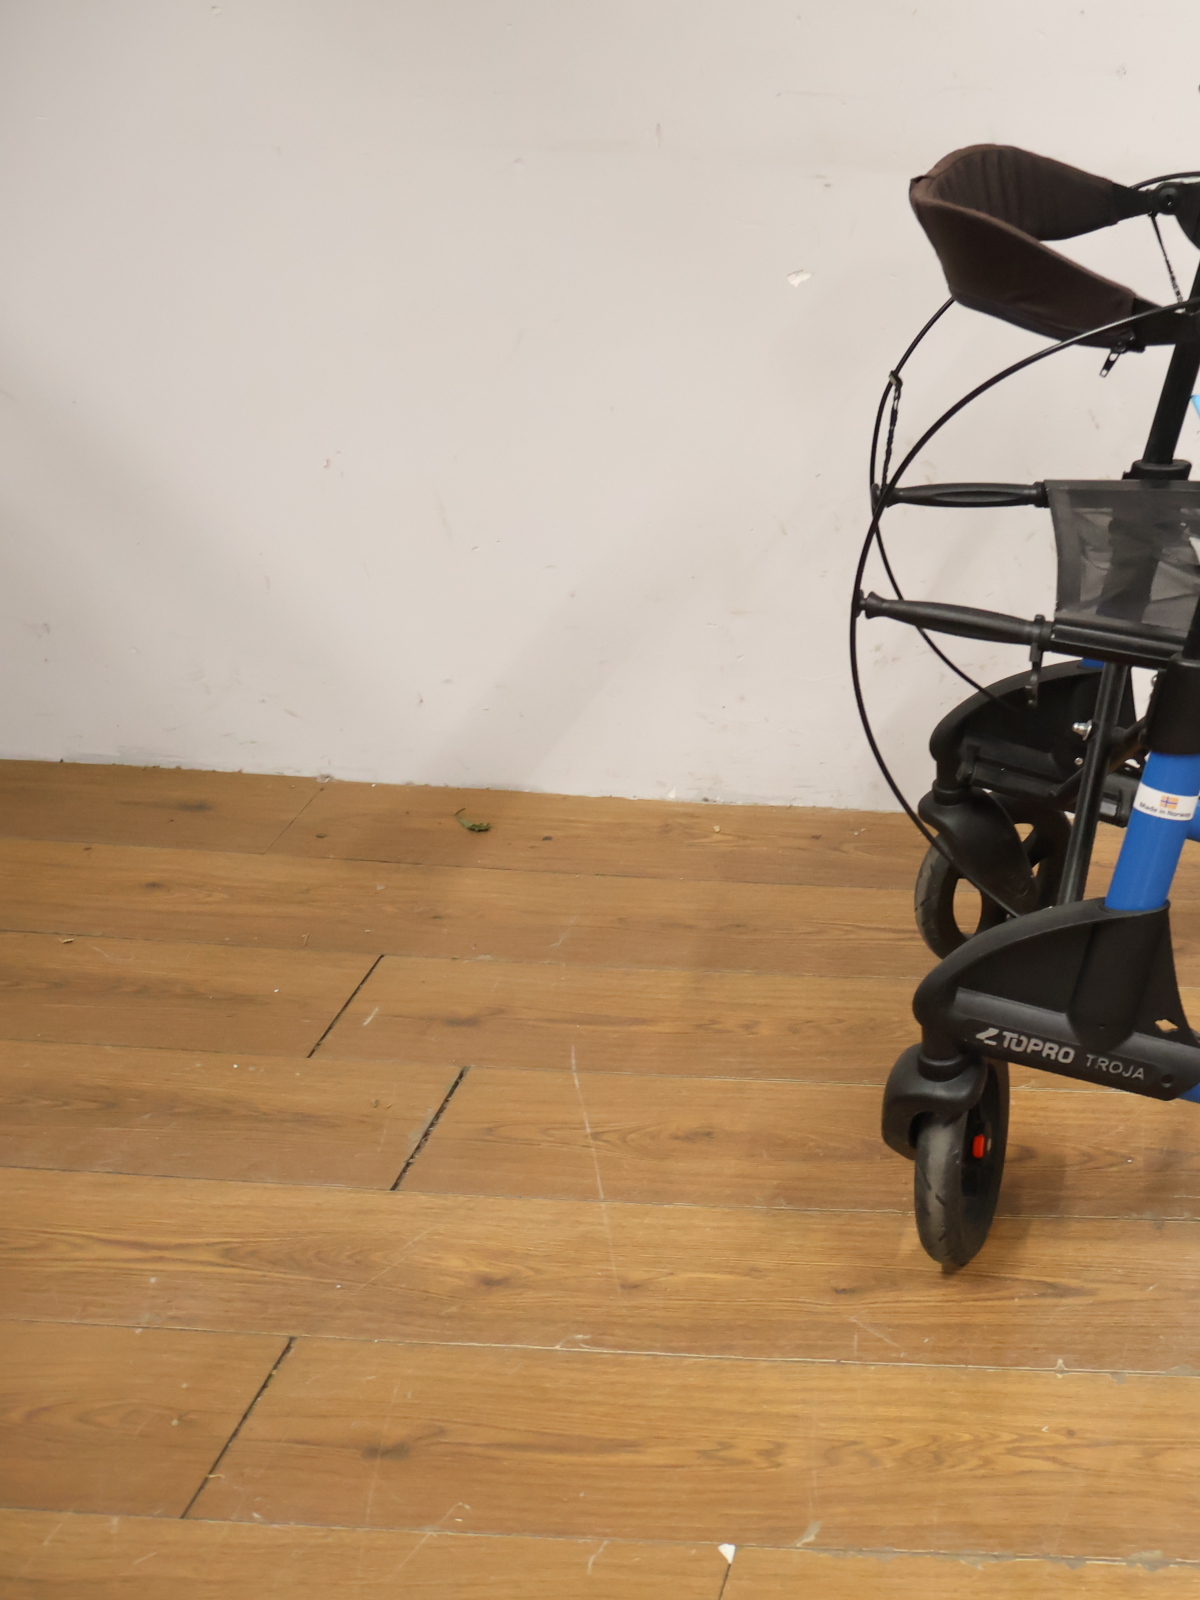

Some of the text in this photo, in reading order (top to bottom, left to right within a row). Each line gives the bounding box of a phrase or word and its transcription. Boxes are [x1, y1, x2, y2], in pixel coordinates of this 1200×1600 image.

[1139, 801, 1158, 812] Made
[1002, 1031, 1144, 1080] TOPRO TROJA
